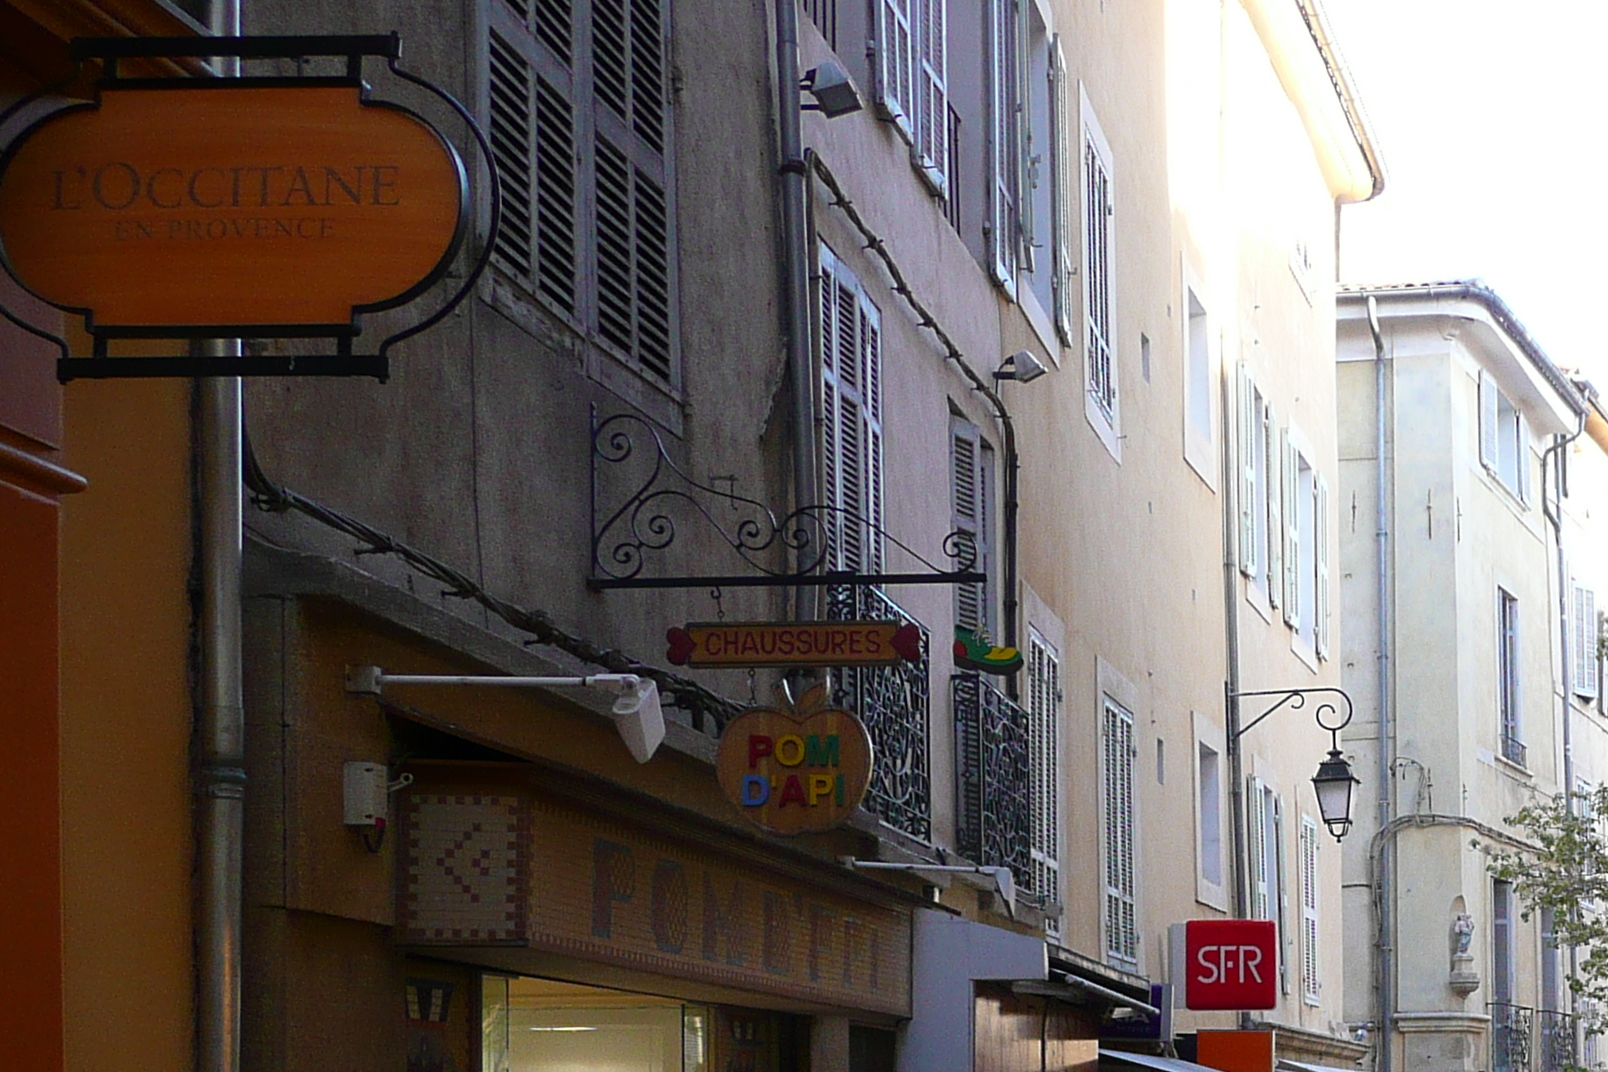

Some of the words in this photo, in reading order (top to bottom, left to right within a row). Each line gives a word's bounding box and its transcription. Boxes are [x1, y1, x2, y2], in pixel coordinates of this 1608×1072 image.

[51, 162, 400, 211] L'OCCITANE
[115, 220, 153, 241] EN
[168, 217, 336, 240] PROVENCE
[703, 630, 881, 657] CHAUSSURES
[748, 734, 839, 768] POM
[741, 774, 844, 808] D'API
[1197, 945, 1262, 983] SFR
